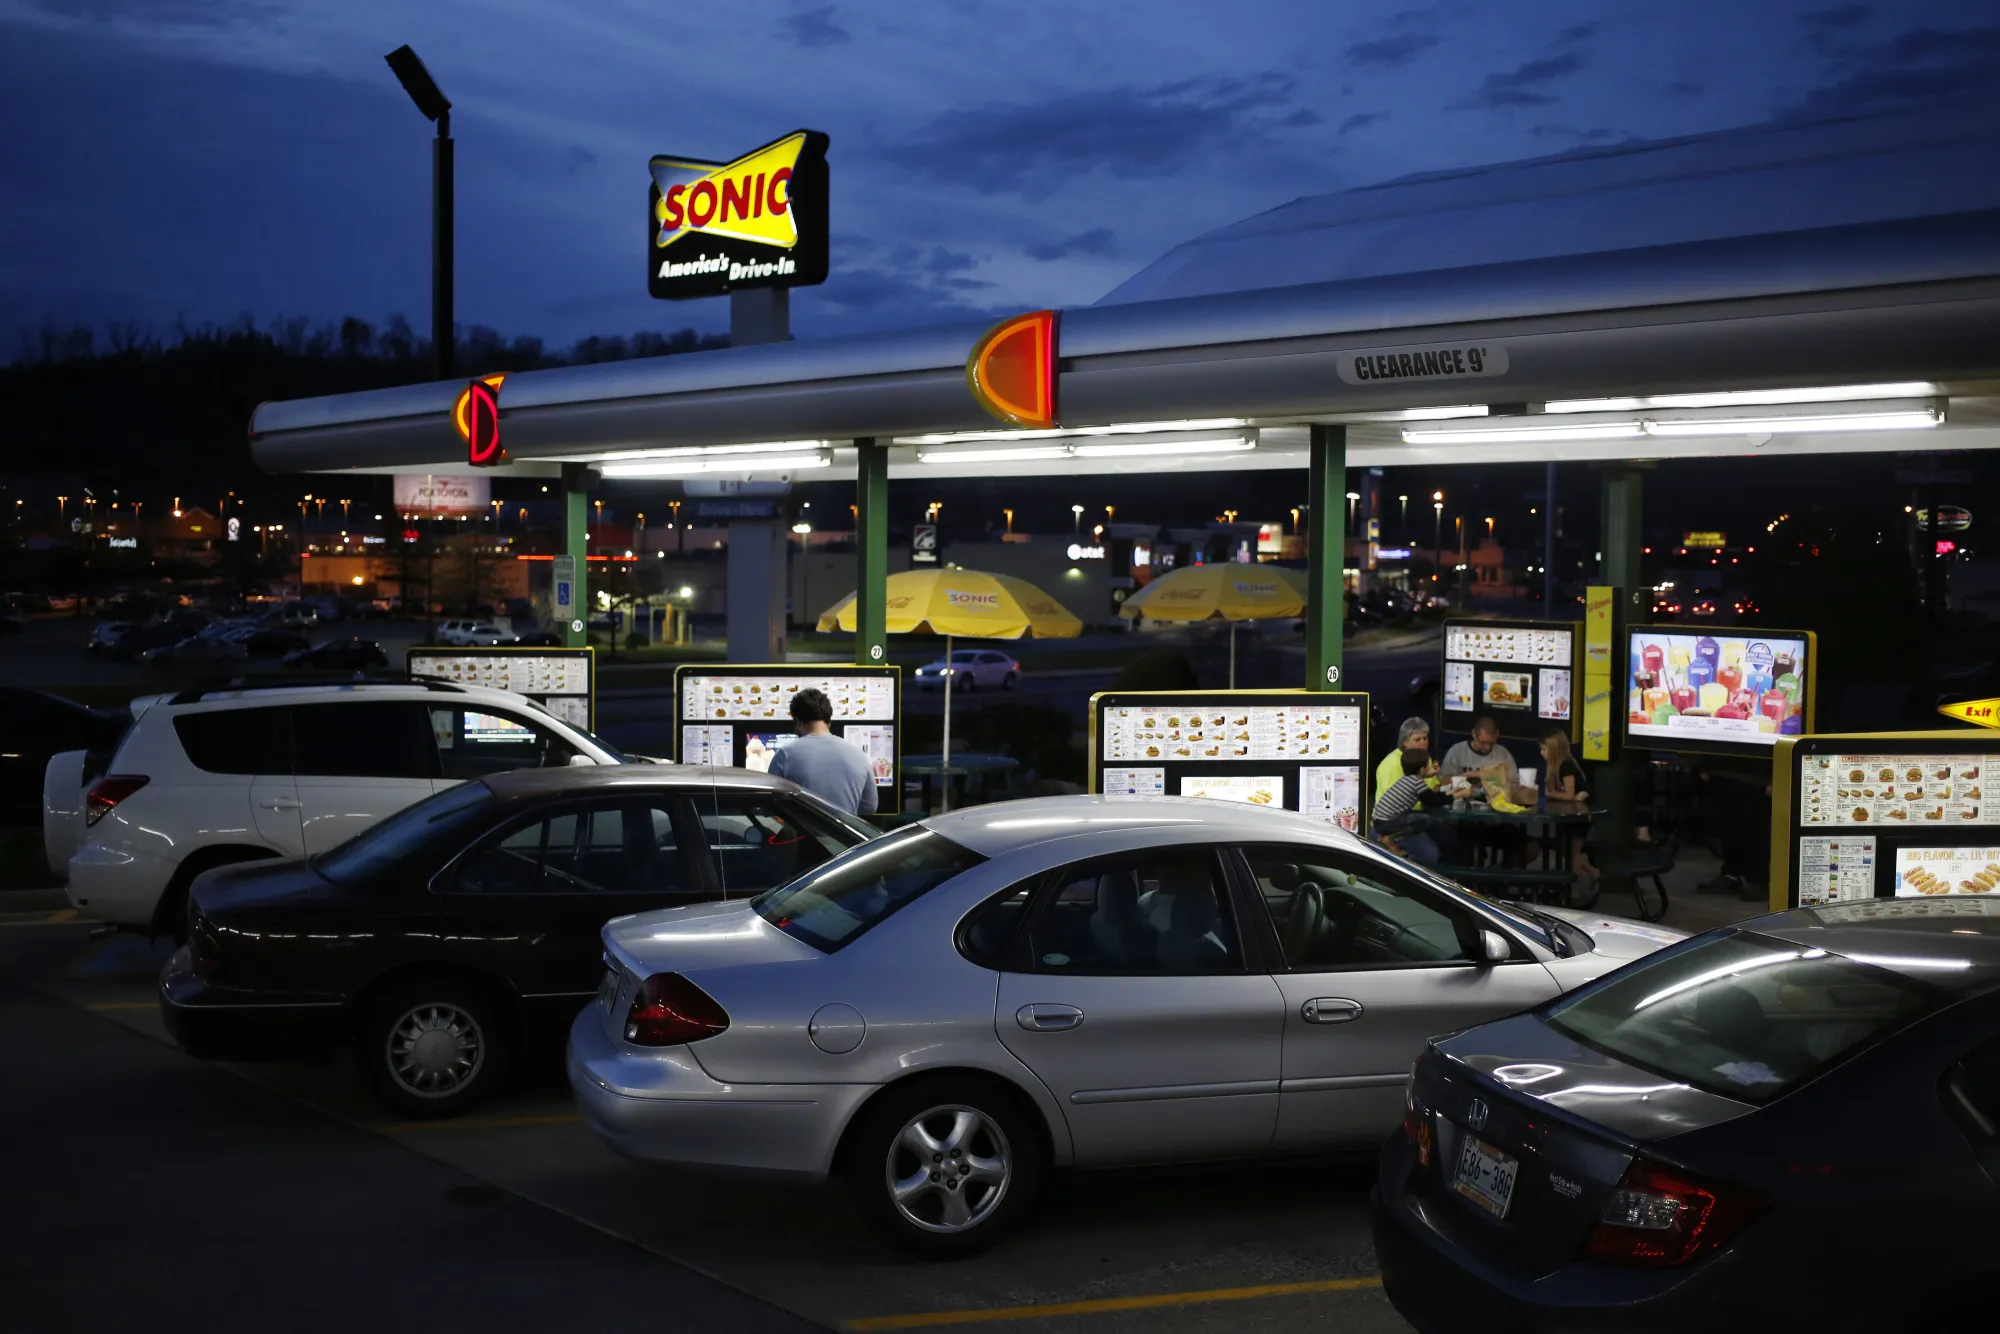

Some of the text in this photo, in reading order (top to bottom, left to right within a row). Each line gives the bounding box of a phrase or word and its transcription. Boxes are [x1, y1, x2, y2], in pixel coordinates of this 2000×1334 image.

[662, 168, 792, 231] SONIC
[658, 253, 729, 278] America's
[1354, 348, 1487, 380] CLEARANCE 9'
[437, 487, 469, 498] TOYOTA
[950, 594, 997, 604] SONIC
[1328, 668, 1337, 680] 26
[1966, 706, 1991, 717] Exit
[1907, 851, 1922, 861] BIG
[1924, 850, 1955, 861] FLAVOR
